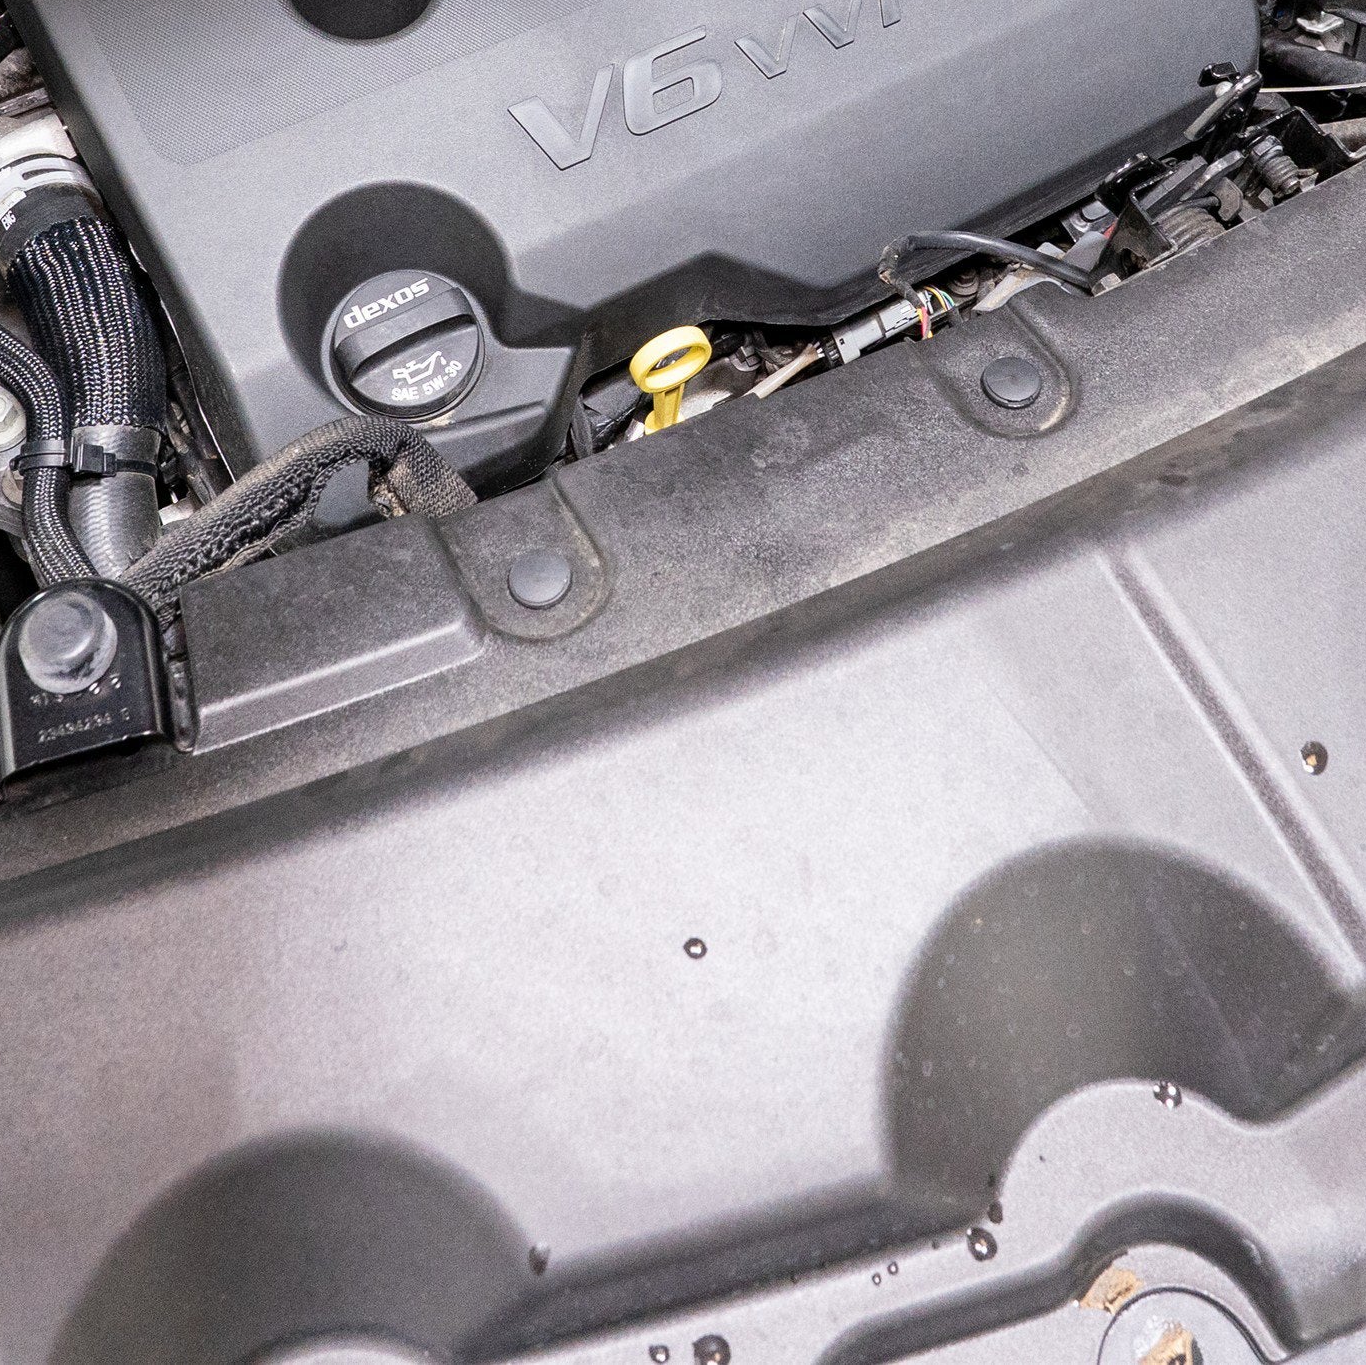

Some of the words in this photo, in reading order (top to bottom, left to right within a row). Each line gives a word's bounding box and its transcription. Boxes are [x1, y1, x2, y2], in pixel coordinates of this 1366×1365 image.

[506, 24, 724, 172] V6
[343, 277, 430, 330] dexos
[391, 387, 420, 402] SAE
[424, 359, 463, 396] 5W-30
